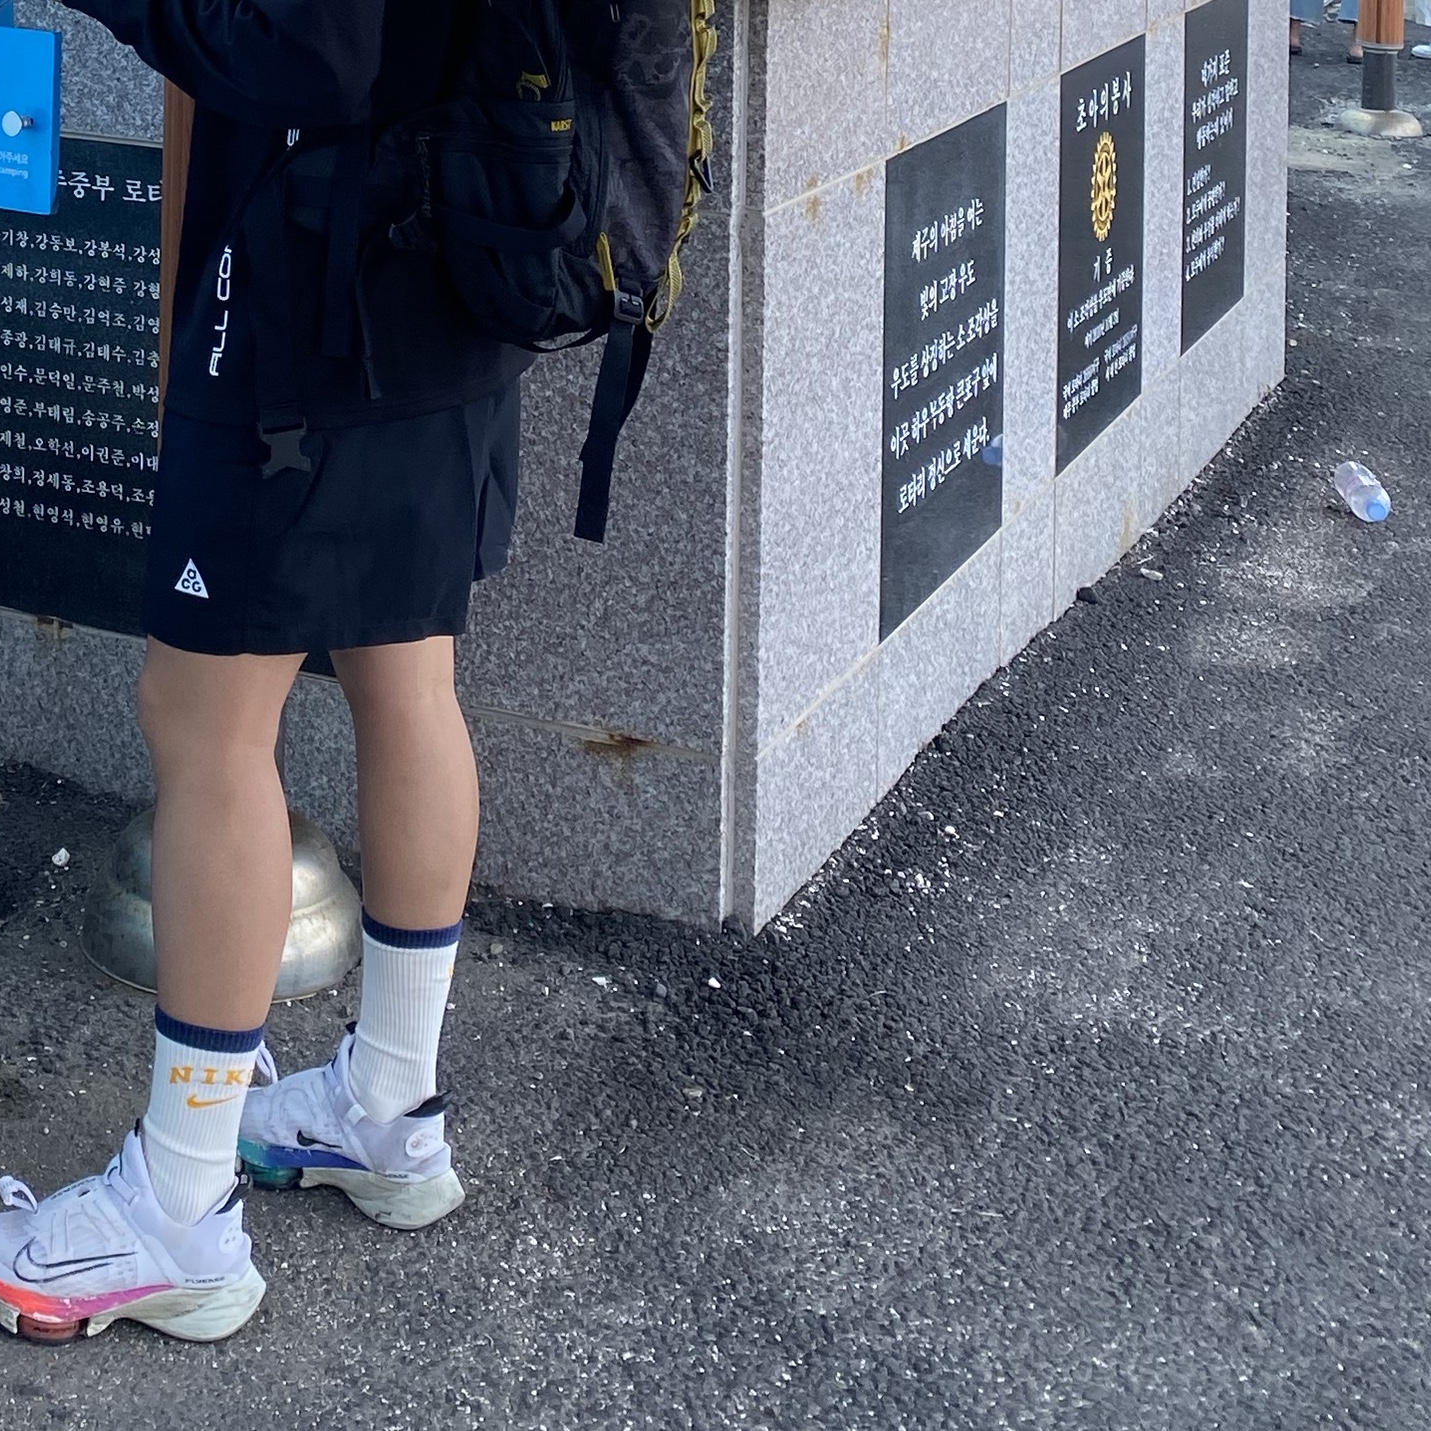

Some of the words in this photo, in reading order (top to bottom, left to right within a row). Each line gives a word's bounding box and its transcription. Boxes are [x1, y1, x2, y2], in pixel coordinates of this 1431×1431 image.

[912, 221, 938, 262] 제주의
[941, 207, 965, 246] 아침을
[967, 199, 983, 230] 여는
[920, 280, 937, 321] 빛의
[939, 269, 957, 304] 고장
[958, 260, 975, 294] 우도
[209, 310, 229, 377] ALL
[891, 354, 919, 399] 우도를
[921, 332, 955, 377] 상징하는
[891, 422, 910, 459] 이곳
[899, 467, 925, 513] 로타리
[927, 441, 961, 490] 정신으로
[963, 417, 989, 459] 세운다.
[169, 1066, 252, 1086] NIK
